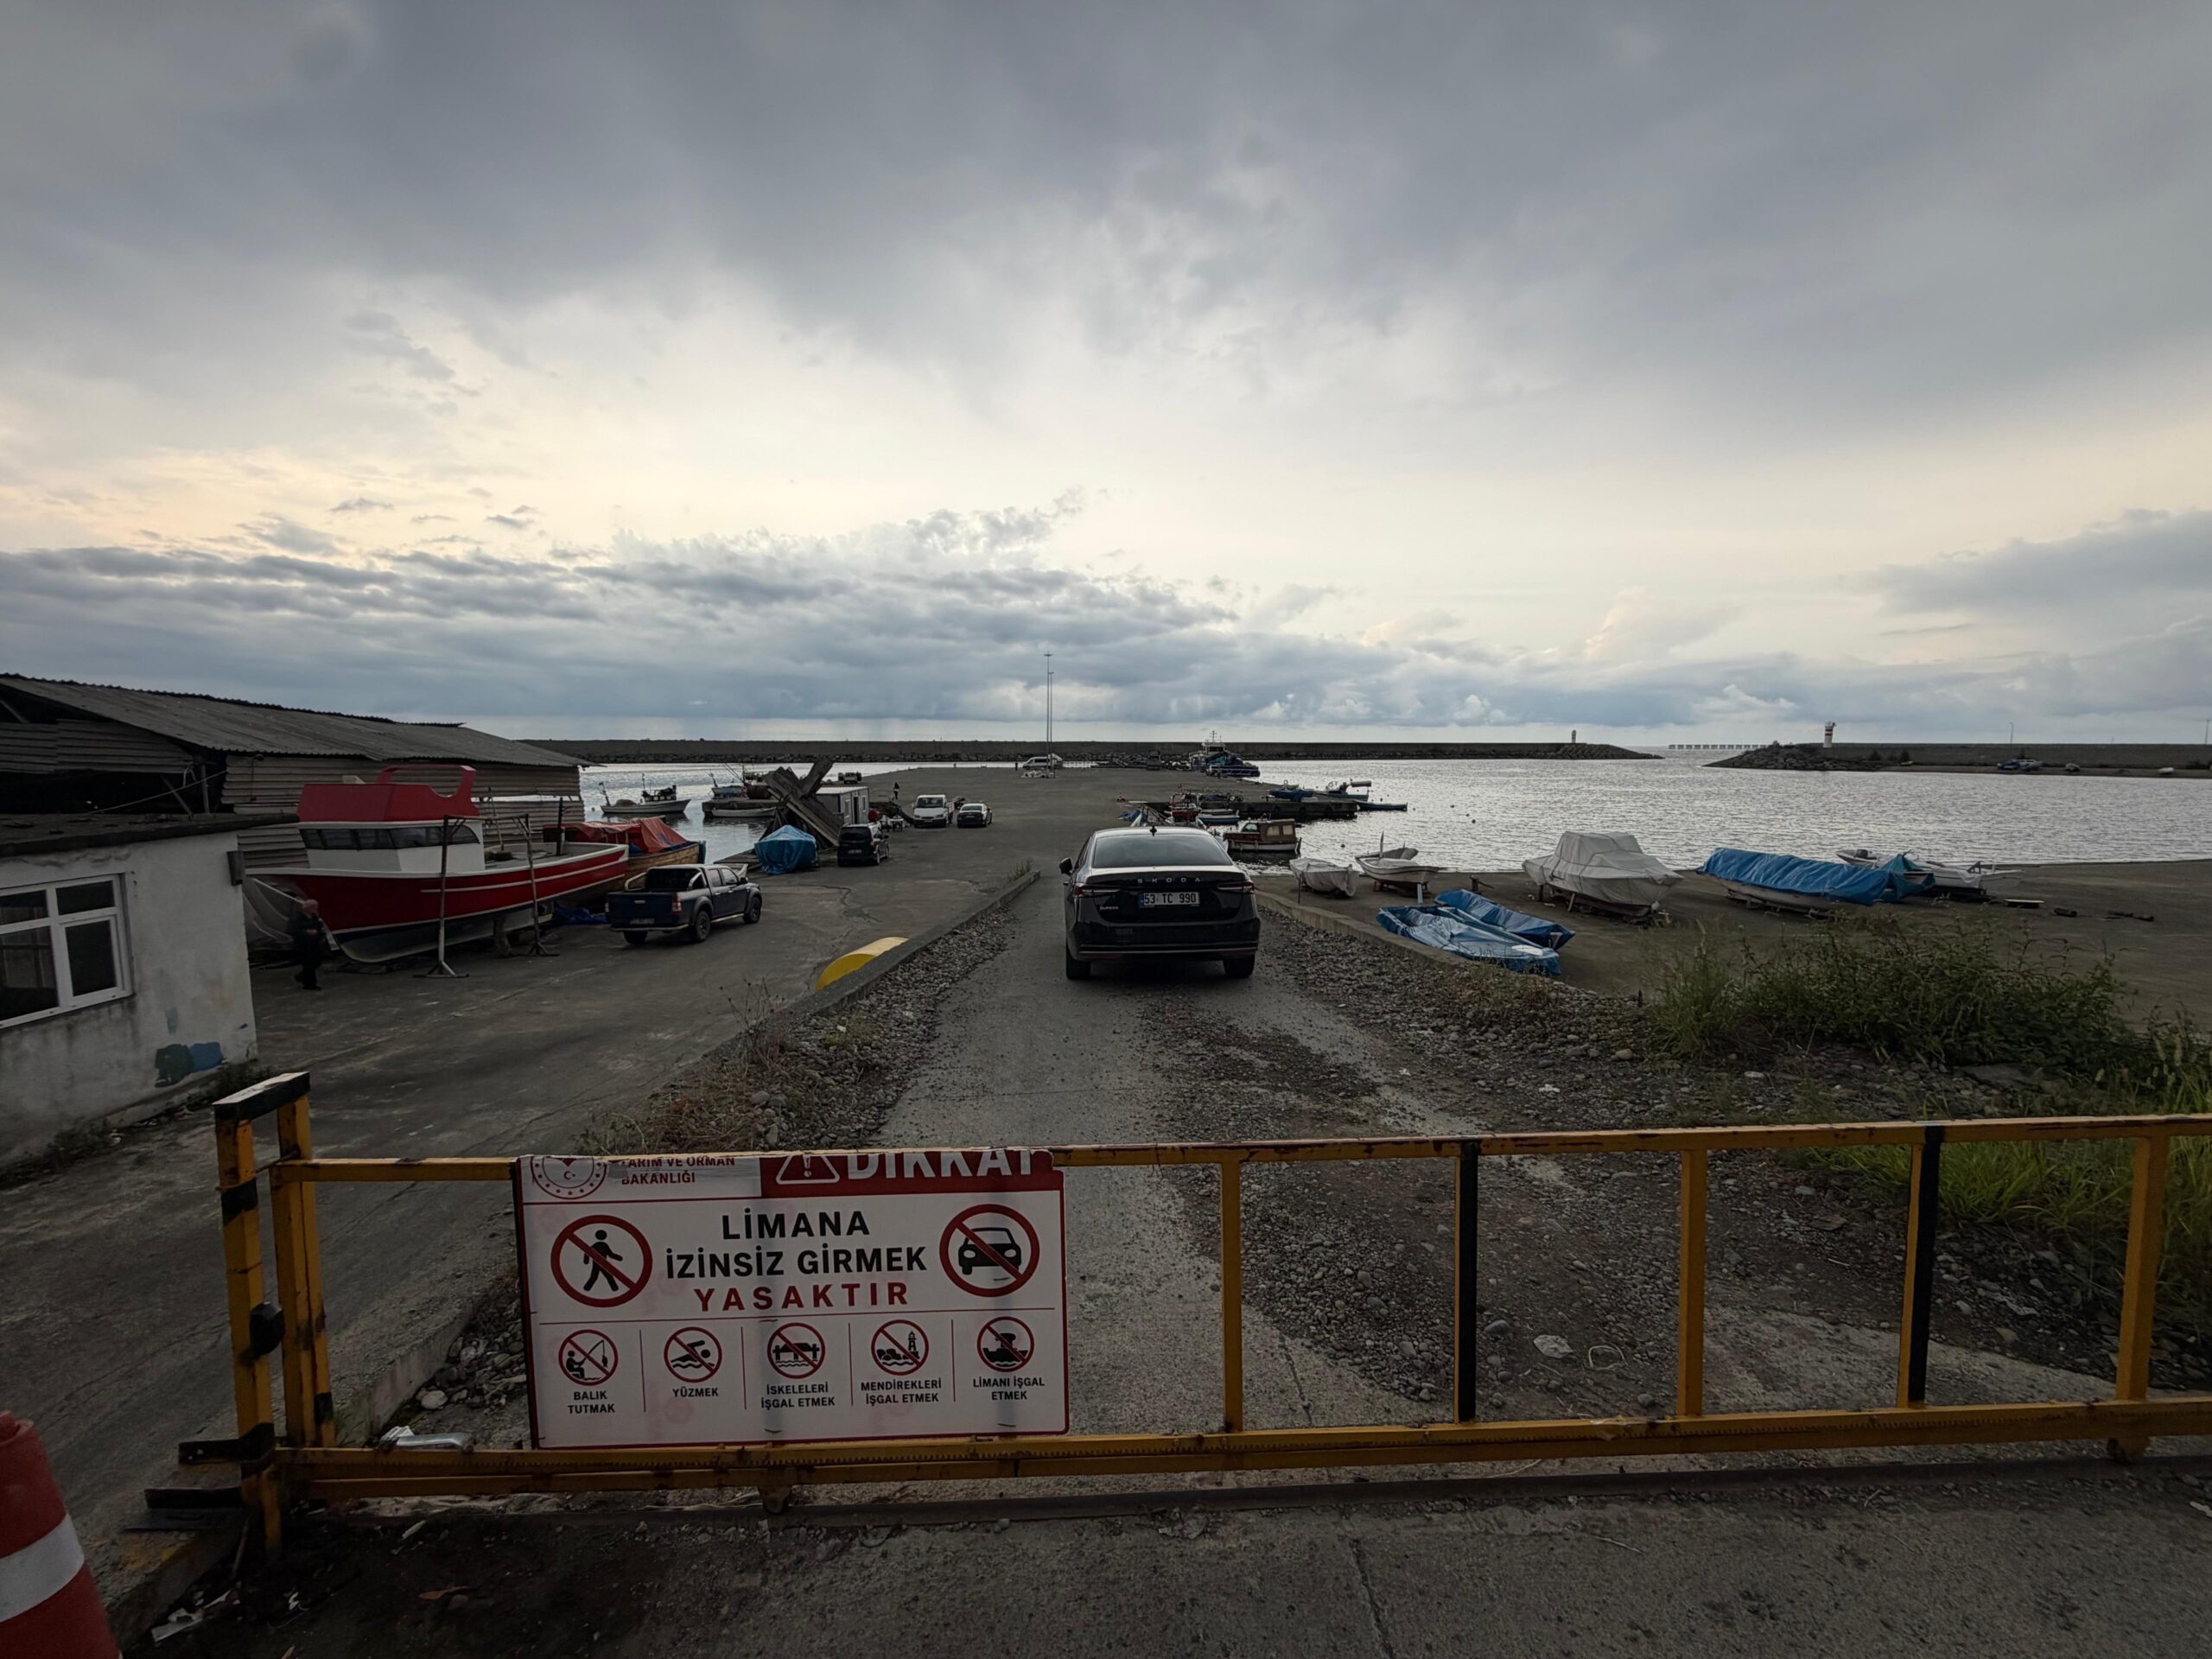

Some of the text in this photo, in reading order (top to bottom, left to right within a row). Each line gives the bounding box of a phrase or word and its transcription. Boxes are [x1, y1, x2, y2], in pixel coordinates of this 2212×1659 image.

[1145, 893, 1197, 904] 53 TC 990
[667, 1158, 683, 1167] VE
[687, 1157, 734, 1166] ORMAN
[722, 1208, 869, 1239] LİMANA
[666, 1243, 926, 1279] İZİNSİZ GİRMEK
[694, 1282, 907, 1312] YASAKTIR
[861, 1380, 942, 1391] MENDİREKLERİ
[973, 1376, 1045, 1389] LİMANI İŞGAL
[672, 1386, 719, 1397] YÜZMEK
[766, 1382, 829, 1395] İSKELELERİ
[573, 1390, 607, 1401] BALIK
[866, 1393, 939, 1405] İŞGAL ETMEK
[991, 1390, 1027, 1401] ETMEK
[760, 1396, 835, 1409] İŞGAL ETMEK
[568, 1403, 615, 1414] TUTMAK
